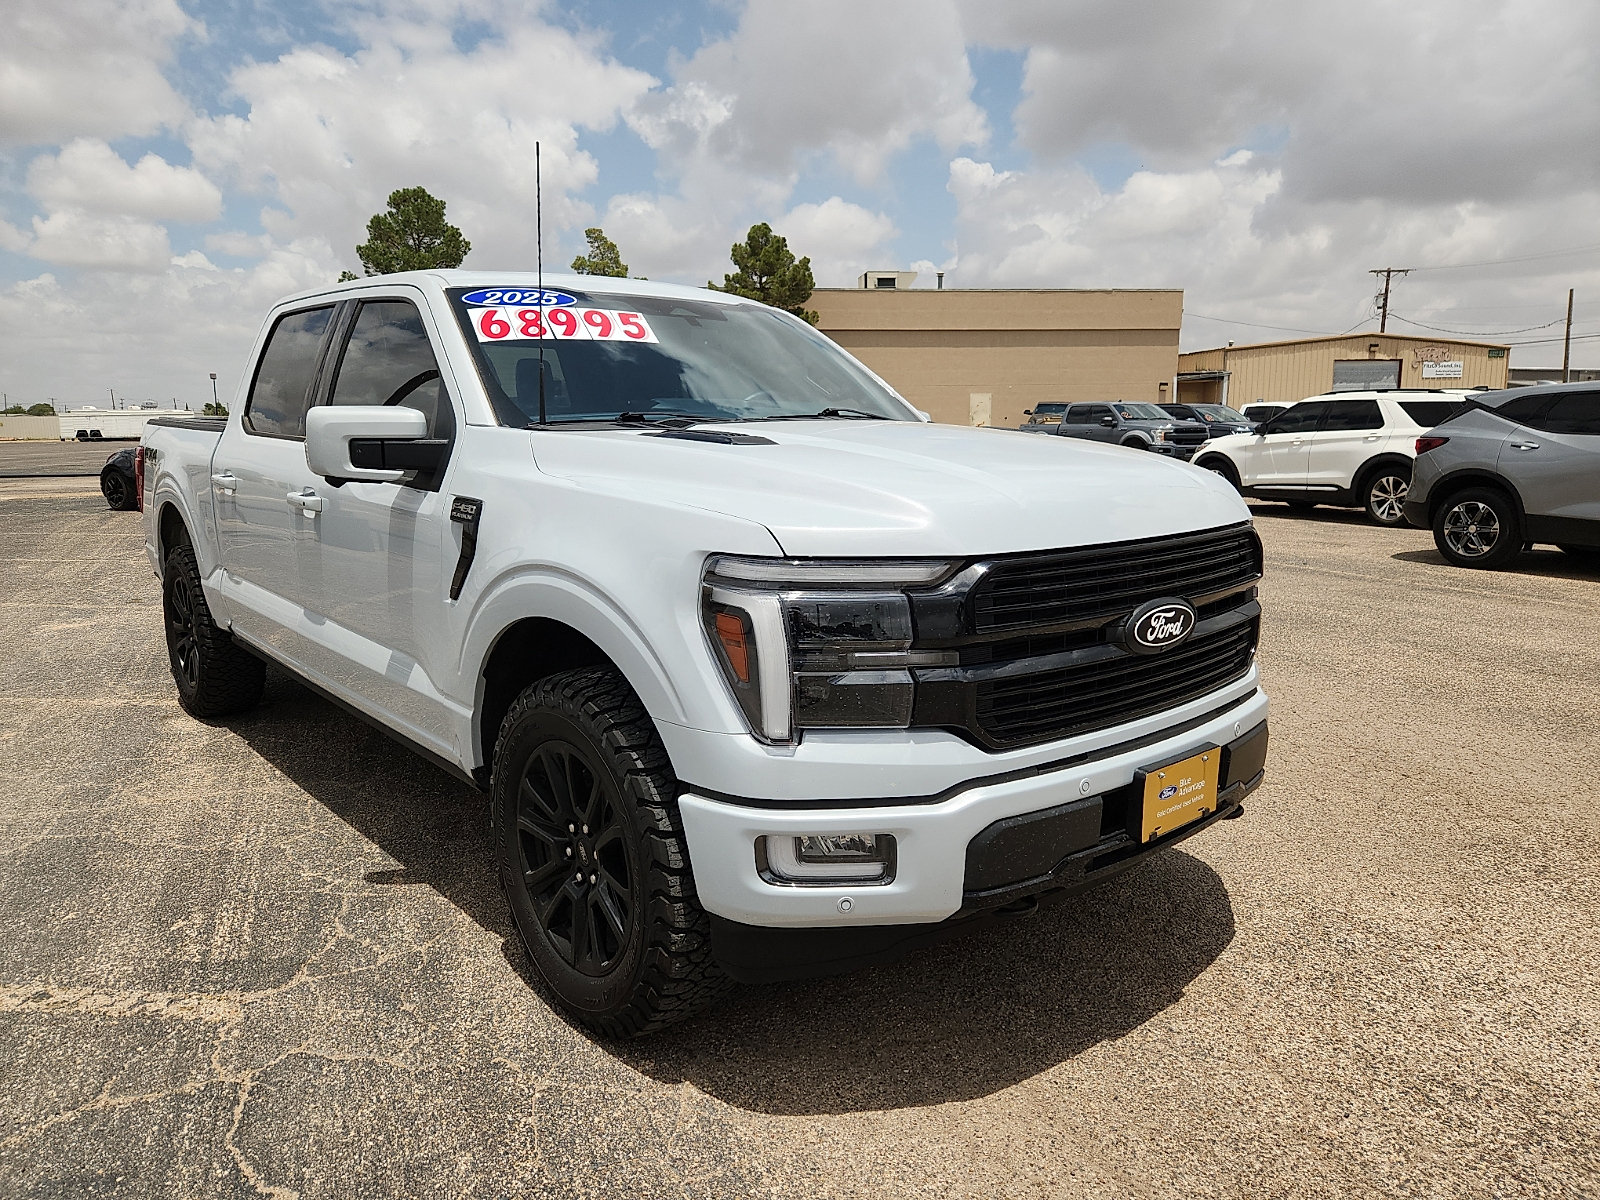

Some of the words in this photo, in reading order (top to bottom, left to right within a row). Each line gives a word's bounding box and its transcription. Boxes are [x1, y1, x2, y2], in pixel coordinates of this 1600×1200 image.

[482, 291, 559, 305] 2025
[479, 308, 647, 339] 68995
[1147, 610, 1185, 641] Ford
[1178, 780, 1206, 797] Advantage
[1179, 777, 1192, 788] Blue
[1161, 786, 1176, 798] Ford
